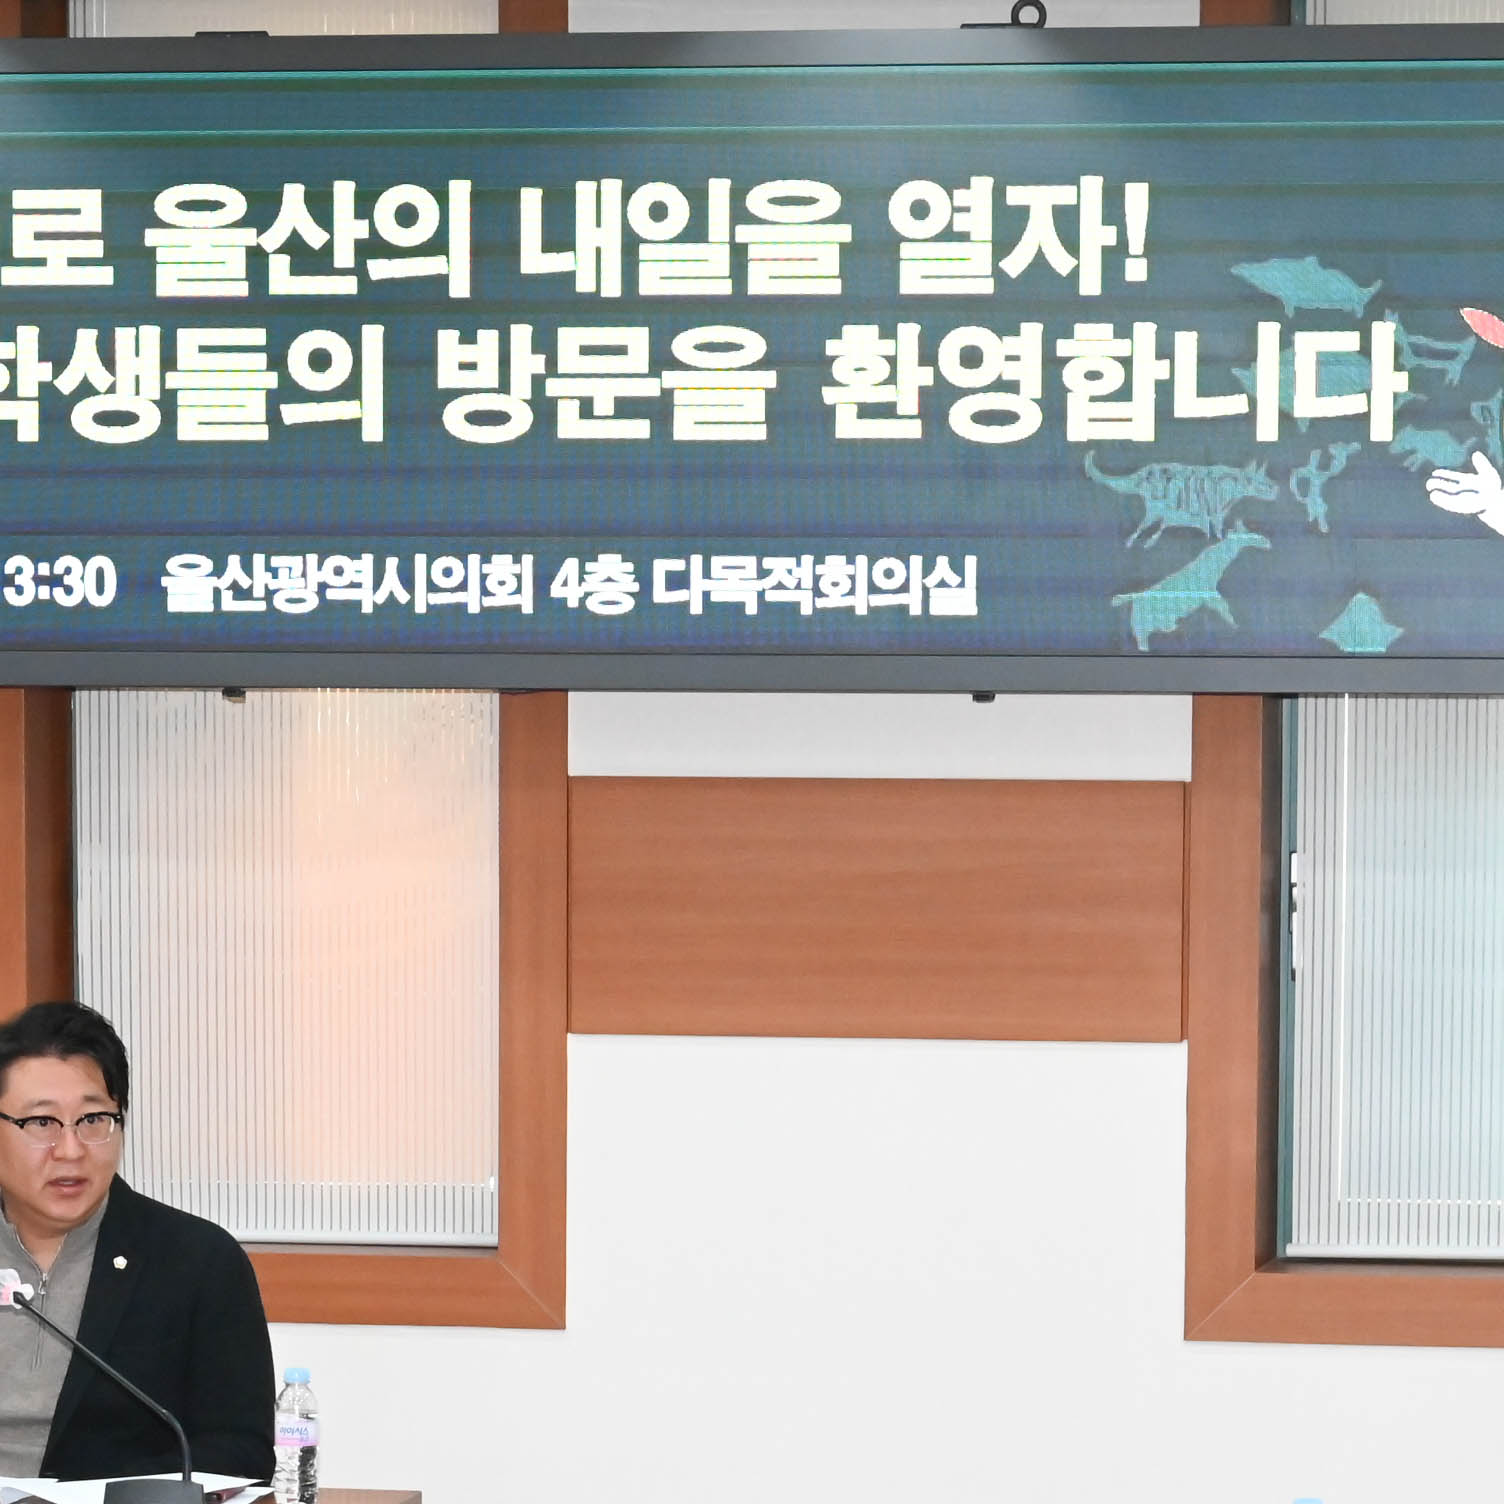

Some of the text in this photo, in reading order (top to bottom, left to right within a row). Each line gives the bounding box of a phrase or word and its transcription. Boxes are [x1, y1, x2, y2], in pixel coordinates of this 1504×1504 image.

[144, 180, 471, 298] 울산의
[521, 178, 852, 297] 내일을
[888, 175, 1148, 296] 열자!
[438, 324, 777, 443] 방문을
[822, 321, 1408, 443] 환영합니다
[161, 554, 533, 614] 울산광역시의회
[550, 554, 639, 615] 4층
[653, 554, 978, 616] 다목적회의실
